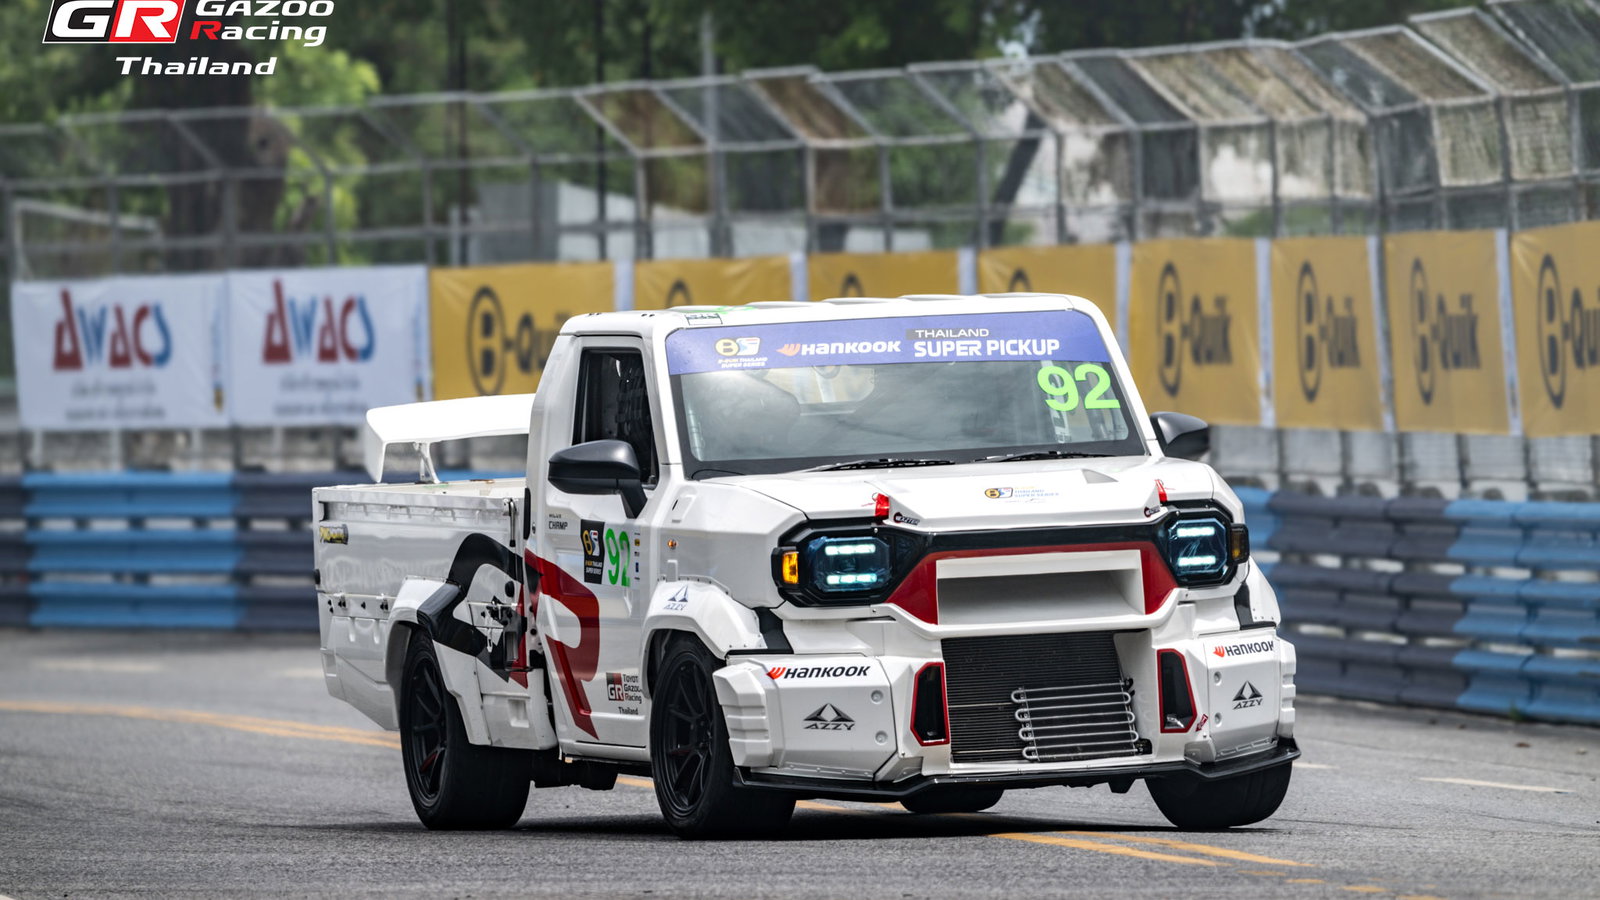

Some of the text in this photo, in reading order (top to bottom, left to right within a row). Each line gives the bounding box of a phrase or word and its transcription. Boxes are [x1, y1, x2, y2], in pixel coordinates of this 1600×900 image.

[915, 327, 989, 339] THAILAND
[801, 341, 901, 356] HANKOOK
[914, 339, 1060, 357] SUPER PICKUP
[1037, 364, 1120, 411] 92
[605, 528, 631, 587] 92
[784, 665, 871, 679] HANKOOK
[608, 683, 624, 701] GR
[624, 693, 642, 704] Racing
[618, 706, 639, 715] Thailand
[1232, 698, 1263, 710] AZZY
[803, 721, 855, 731] AZZY
